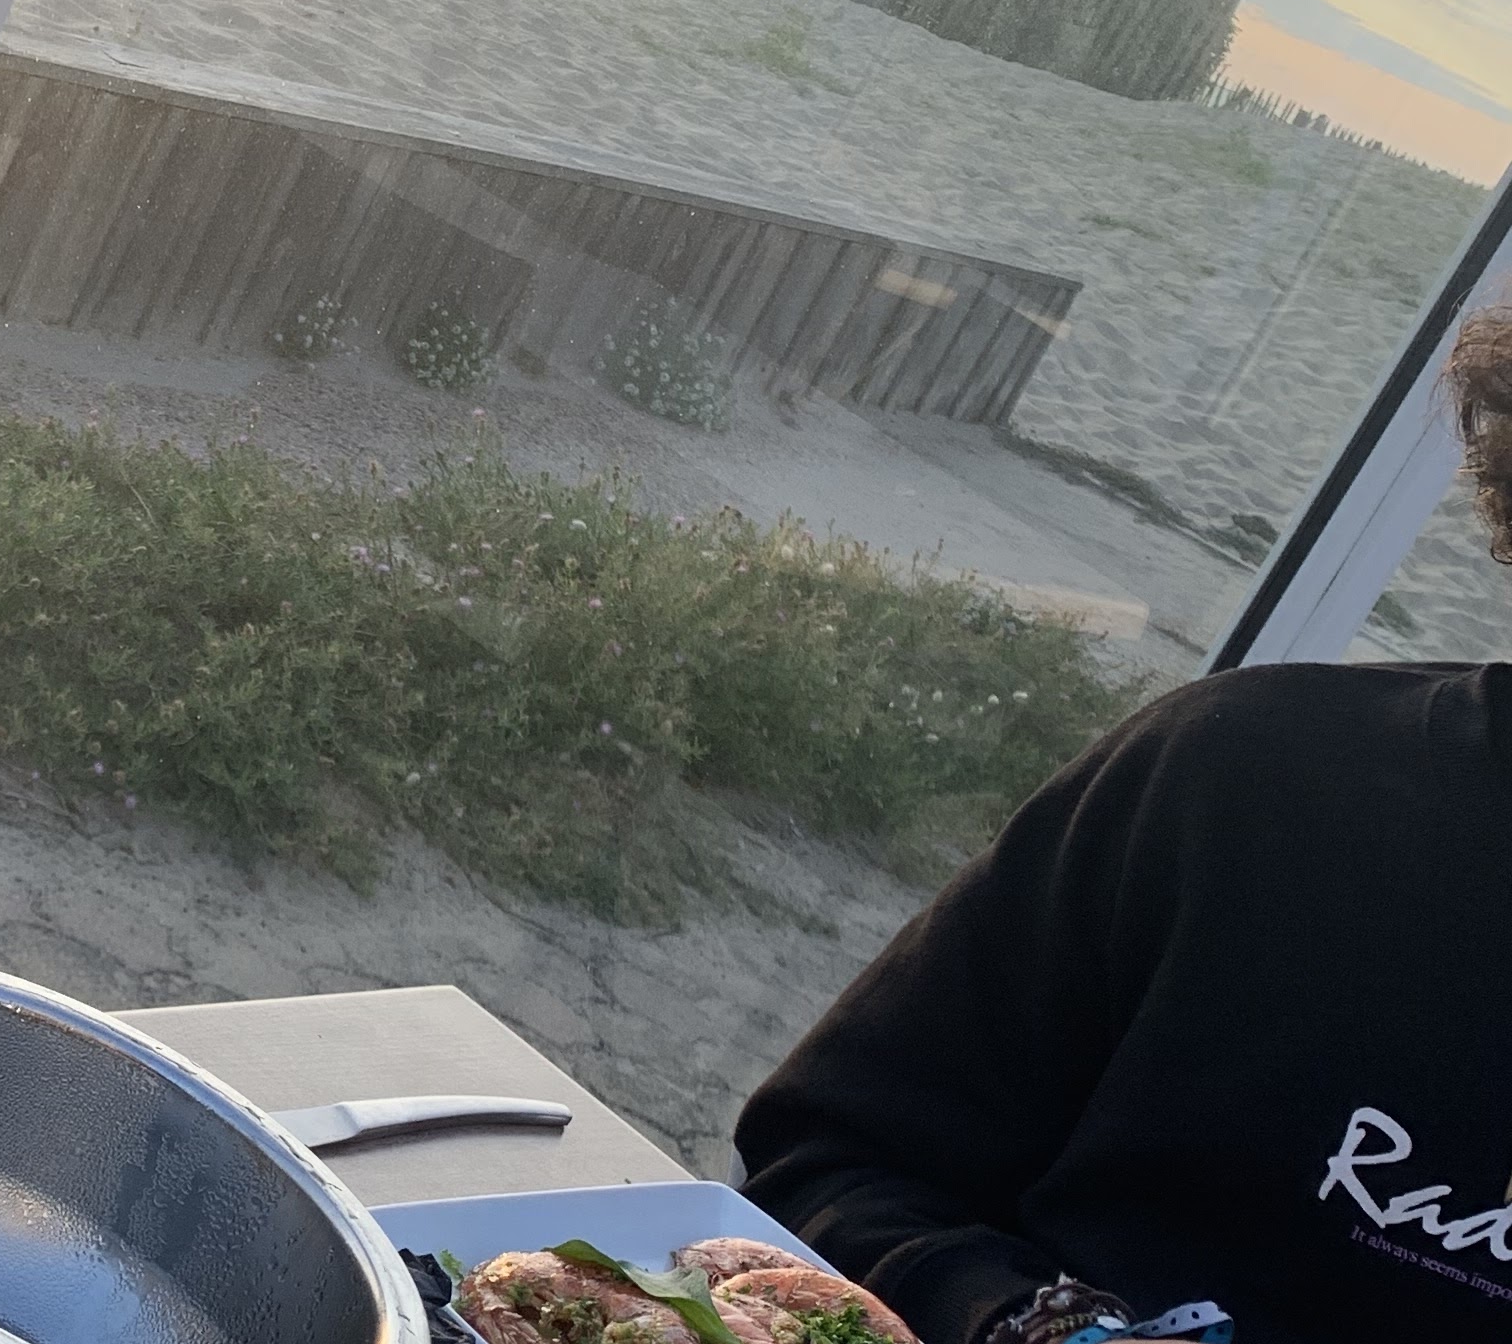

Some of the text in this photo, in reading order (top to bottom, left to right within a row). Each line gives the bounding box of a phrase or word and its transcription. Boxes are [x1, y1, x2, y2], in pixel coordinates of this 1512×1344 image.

[1350, 1226, 1512, 1301] It always seems impo
